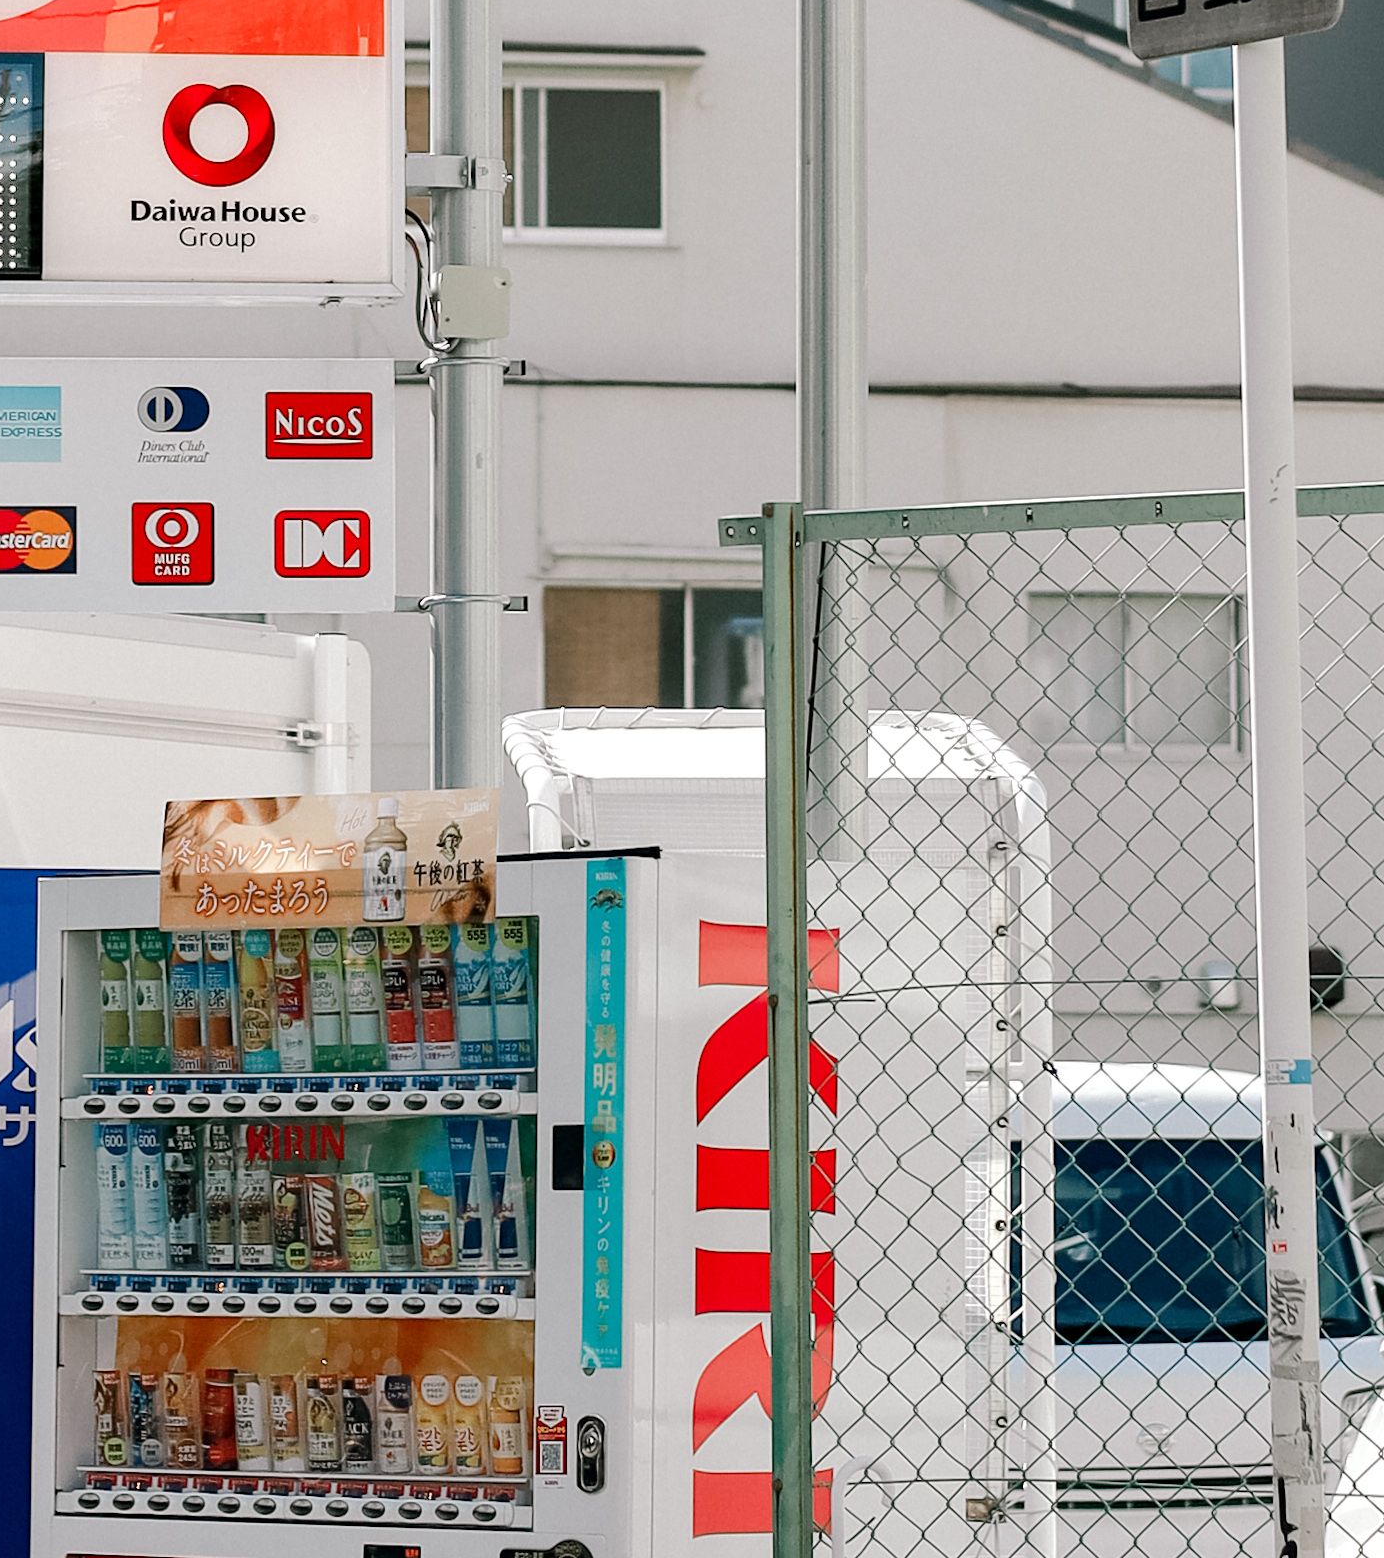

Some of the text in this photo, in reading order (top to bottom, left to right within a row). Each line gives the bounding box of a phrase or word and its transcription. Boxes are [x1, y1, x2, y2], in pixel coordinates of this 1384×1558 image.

[130, 199, 306, 223] Daiwa House
[178, 225, 257, 250] Group
[1, 427, 63, 438] EXPRESS
[137, 452, 210, 464] International
[141, 440, 205, 452] Diners Club
[283, 520, 363, 568] DC
[154, 553, 190, 564] MUFG
[154, 565, 190, 576] CARD
[340, 807, 367, 833] Hot
[174, 836, 357, 874] 冬はミルクティーで
[413, 860, 485, 886] 午後の紅茶
[195, 878, 331, 917] あったまろう
[246, 1124, 345, 1162] KIRIN
[312, 1182, 335, 1247] Mets
